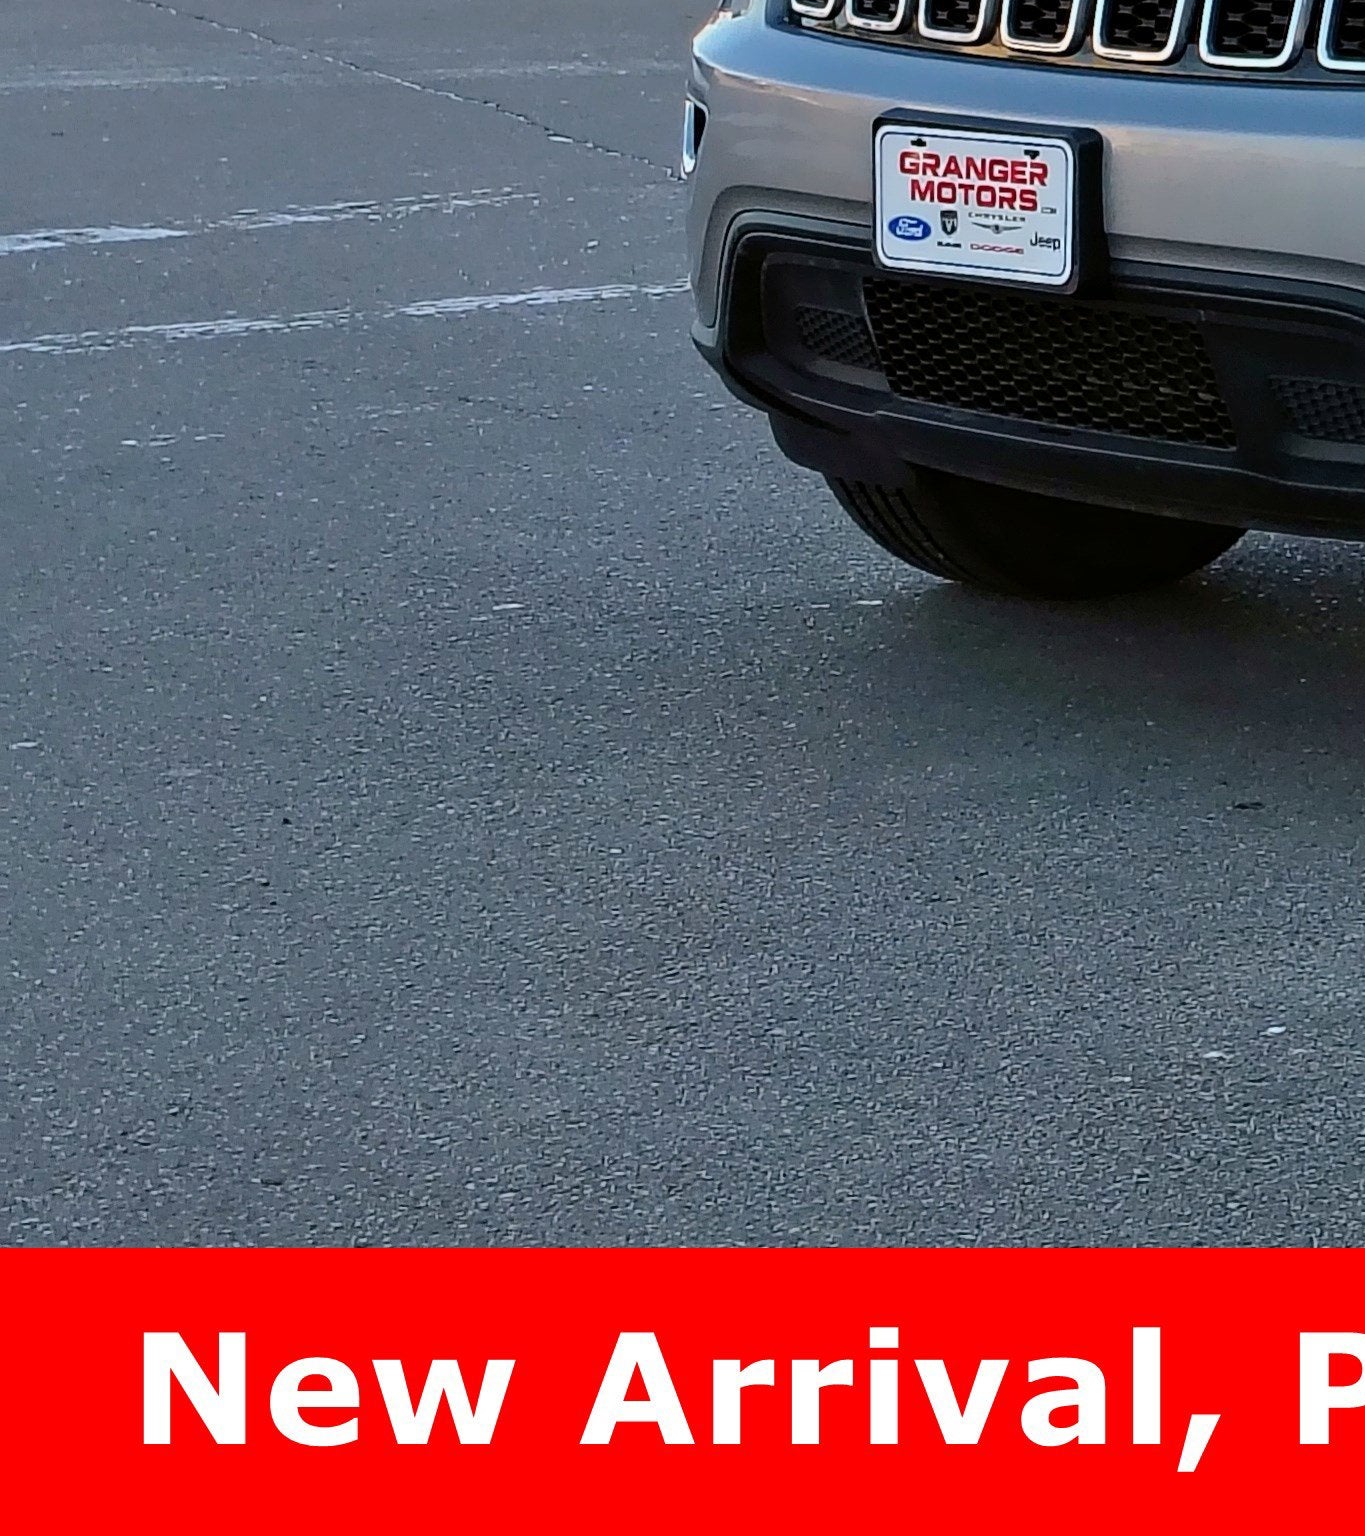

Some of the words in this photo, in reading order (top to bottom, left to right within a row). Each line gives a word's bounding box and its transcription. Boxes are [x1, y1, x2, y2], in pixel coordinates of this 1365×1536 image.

[899, 150, 1048, 187] GRANGER
[910, 179, 1038, 213] MOTORS
[968, 211, 1026, 223] CHRYSLER
[893, 217, 926, 239] Ford
[970, 242, 1025, 255] DODGE
[1030, 231, 1061, 251] Jeep
